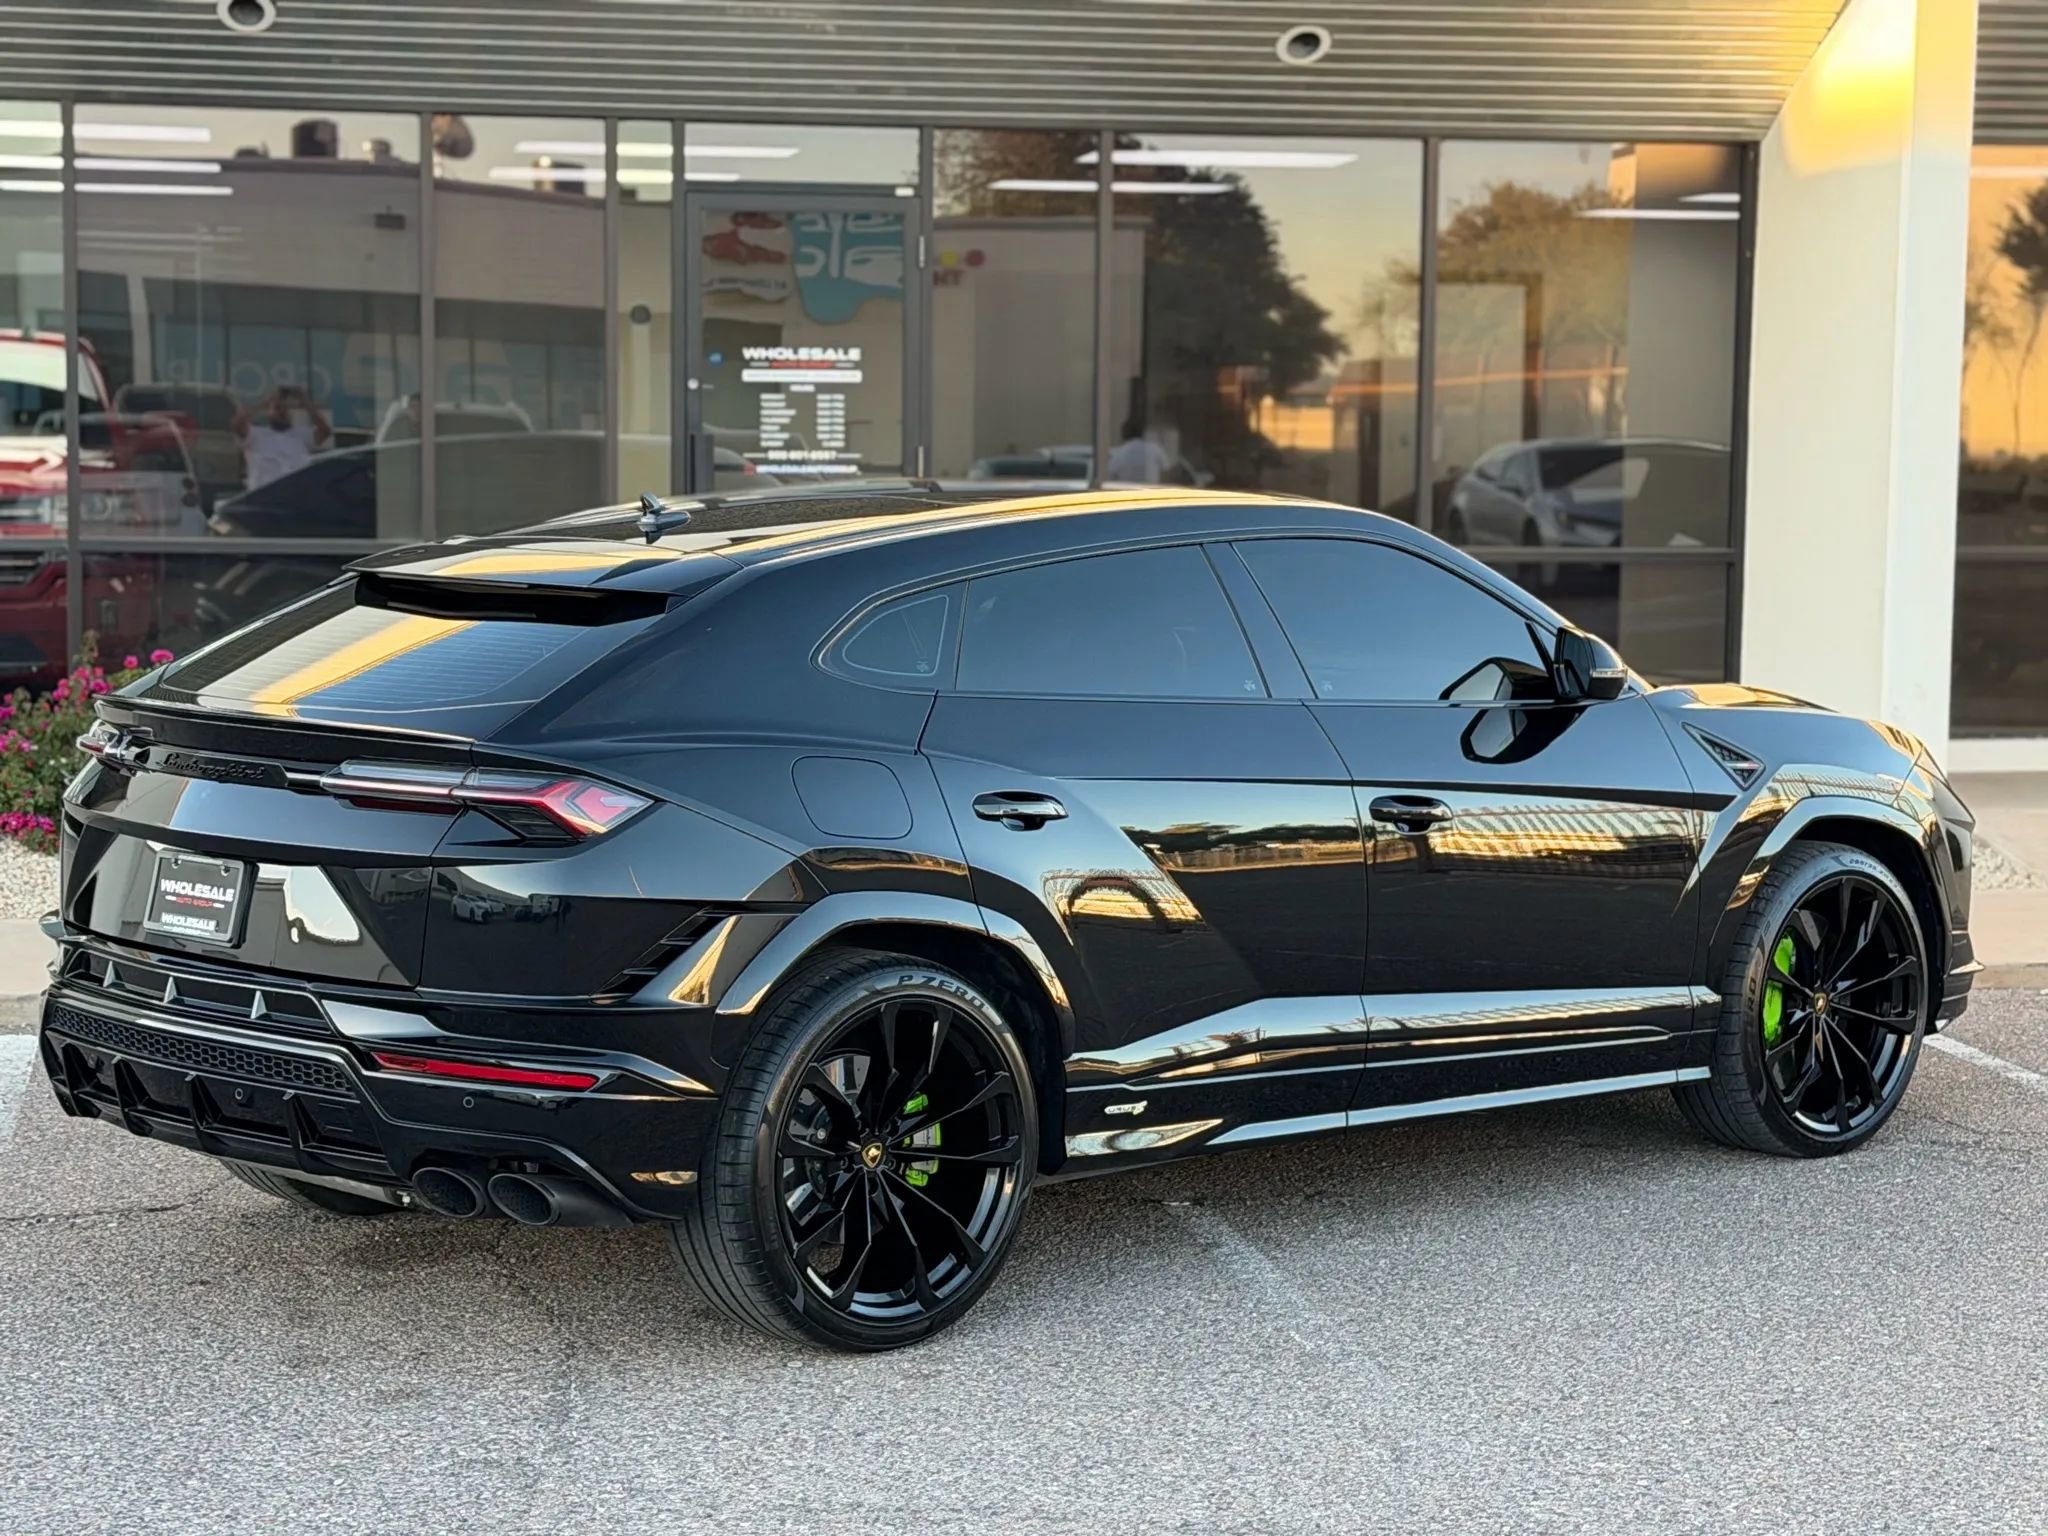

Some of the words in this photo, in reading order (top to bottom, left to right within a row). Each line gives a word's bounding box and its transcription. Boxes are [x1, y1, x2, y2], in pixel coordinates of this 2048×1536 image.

[742, 347, 861, 361] WHOLESALE
[161, 879, 235, 902] WHOLESALE
[161, 912, 217, 932] WHOLESALE
[898, 975, 913, 986] P
